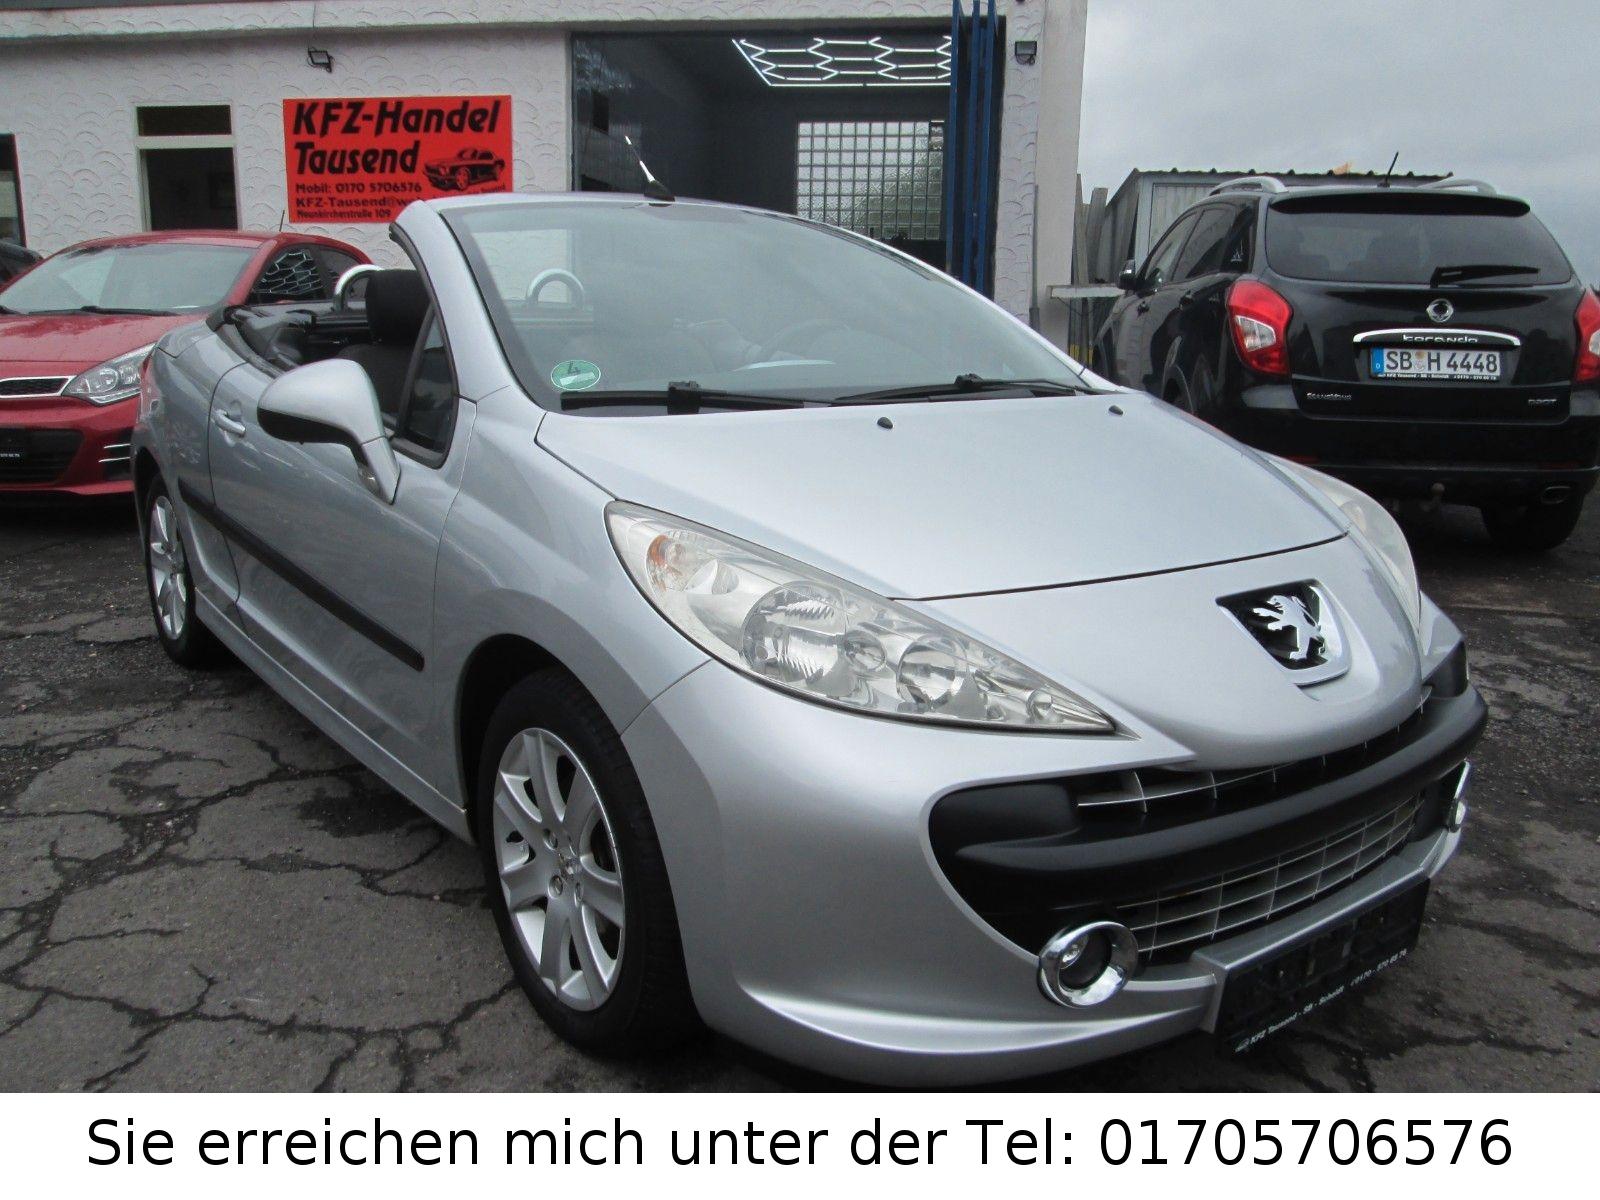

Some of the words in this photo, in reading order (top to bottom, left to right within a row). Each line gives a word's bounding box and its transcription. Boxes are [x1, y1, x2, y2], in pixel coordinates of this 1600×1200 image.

[293, 100, 501, 138] KFZ-Handel
[295, 140, 420, 175] Tausend
[296, 183, 331, 193] Mobil:
[335, 182, 365, 193] 0170
[369, 182, 422, 193] 5706576
[374, 209, 391, 218] 109
[1386, 351, 1412, 370] SB
[1427, 352, 1441, 371] H
[1446, 352, 1498, 373] 4448
